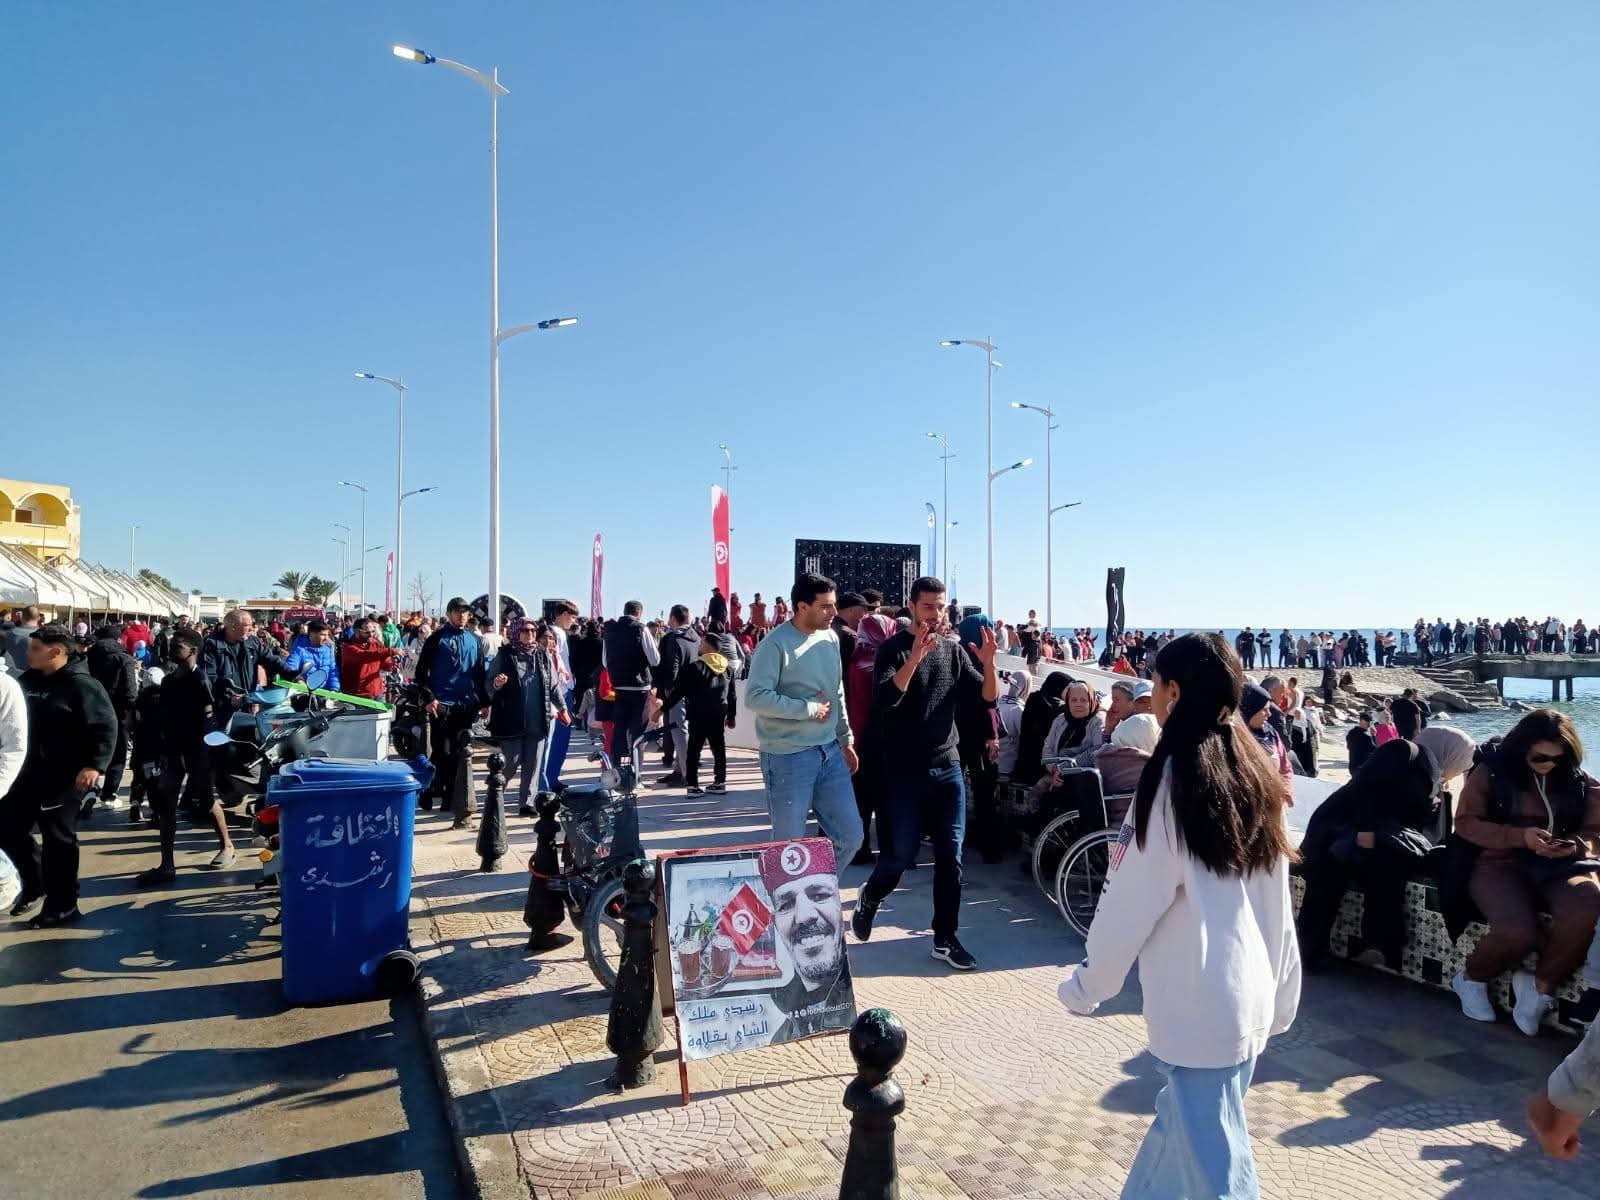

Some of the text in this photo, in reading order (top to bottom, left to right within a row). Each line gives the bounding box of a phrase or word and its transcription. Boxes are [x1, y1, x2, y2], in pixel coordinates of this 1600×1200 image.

[688, 1000, 764, 1022] رشدي ملك
[688, 1020, 769, 1049] الشاي بقلاوة
